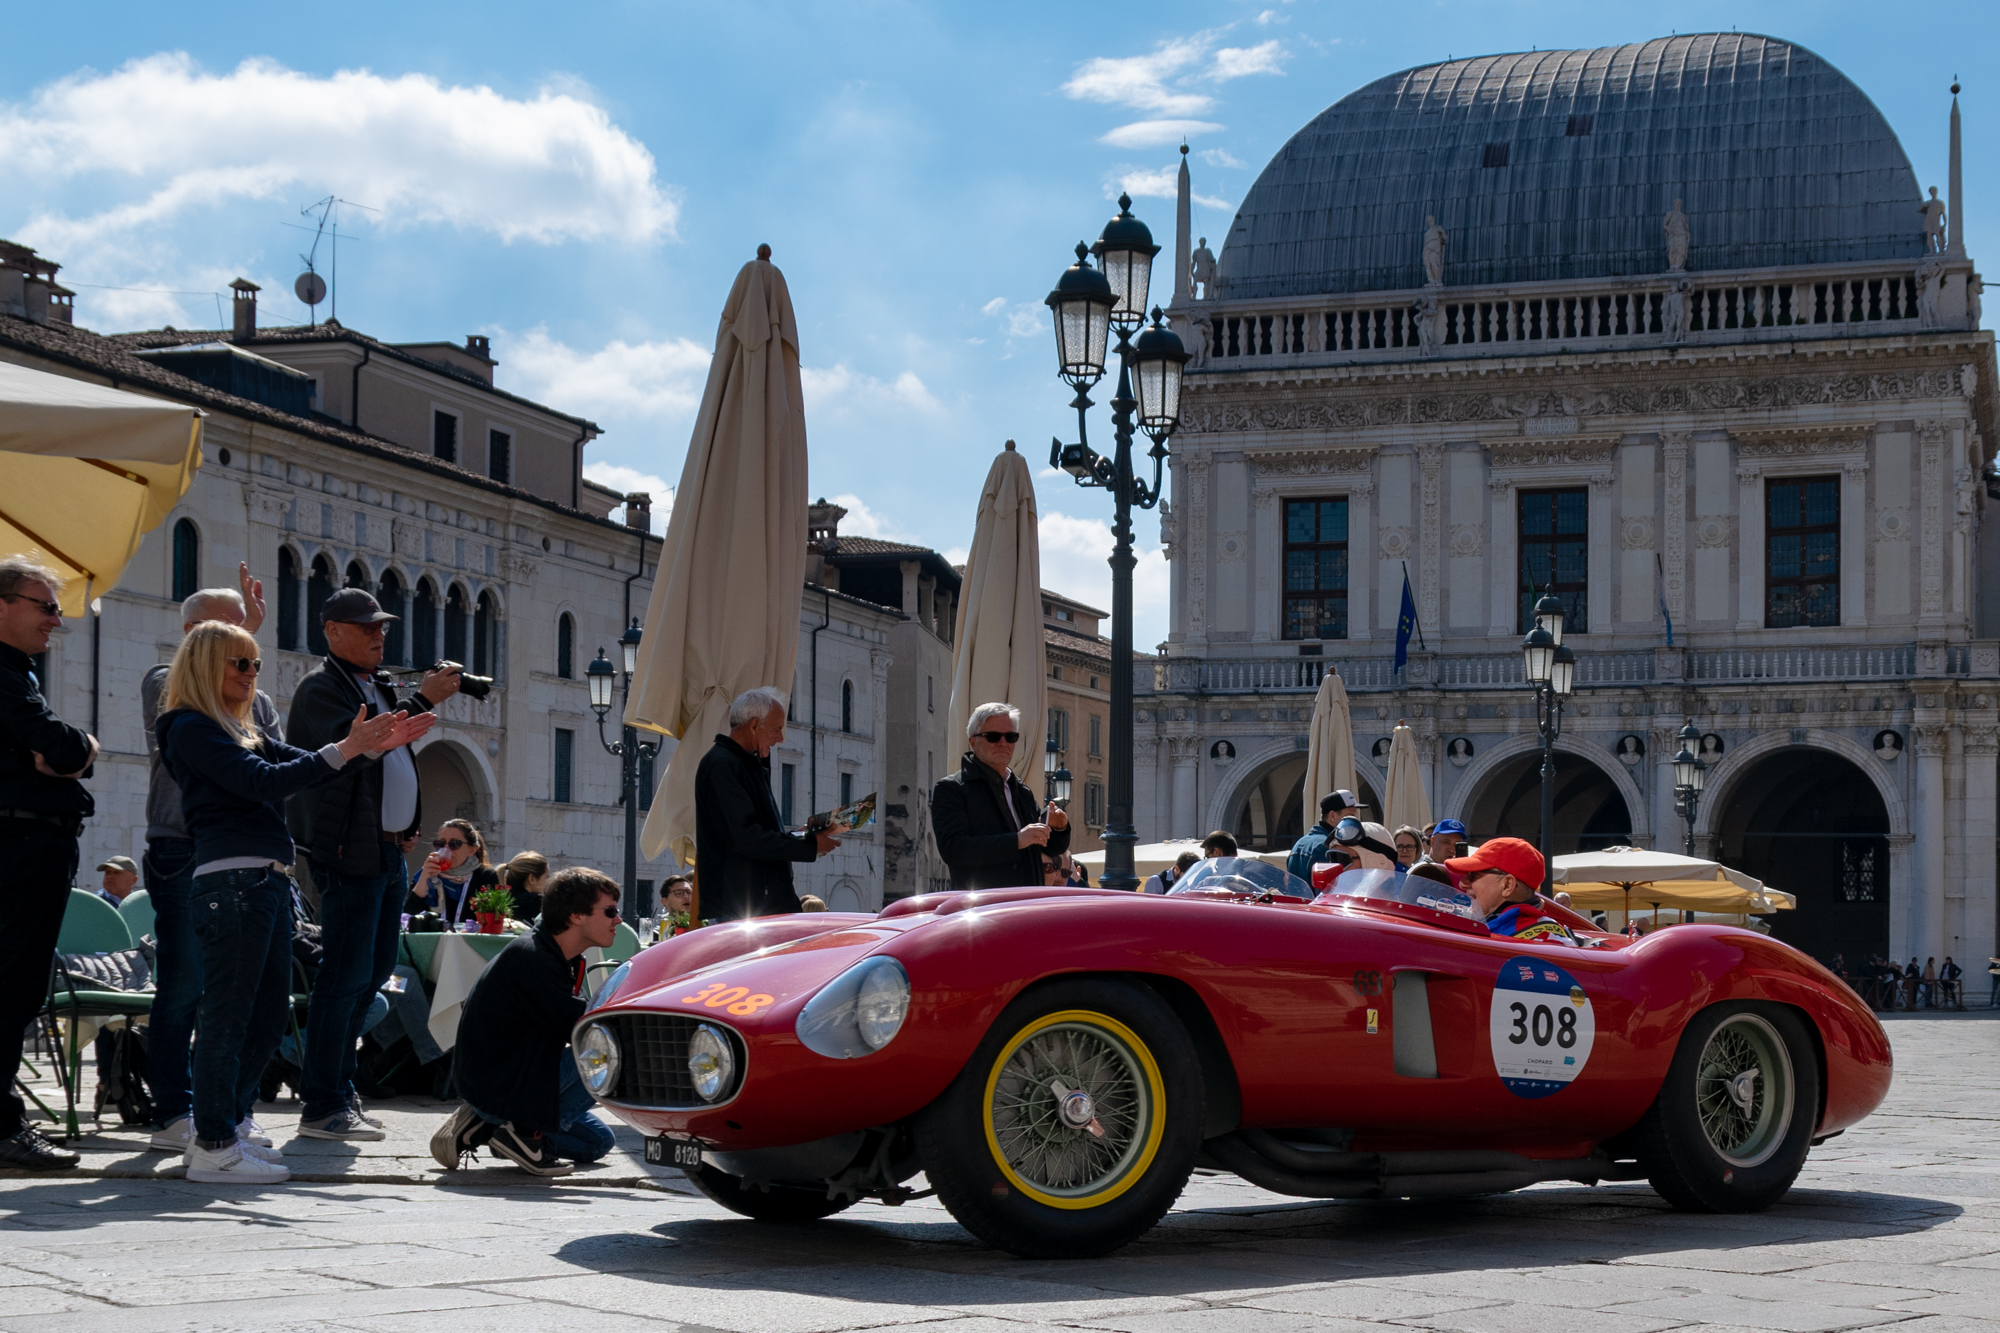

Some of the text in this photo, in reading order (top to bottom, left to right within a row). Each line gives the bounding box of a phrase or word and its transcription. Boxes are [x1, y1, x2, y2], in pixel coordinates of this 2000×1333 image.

[1520, 925, 1561, 939] Sabe
[1353, 969, 1383, 997] 69
[681, 982, 775, 1016] 308
[1508, 1001, 1577, 1048] 308
[674, 1144, 699, 1166] 8128
